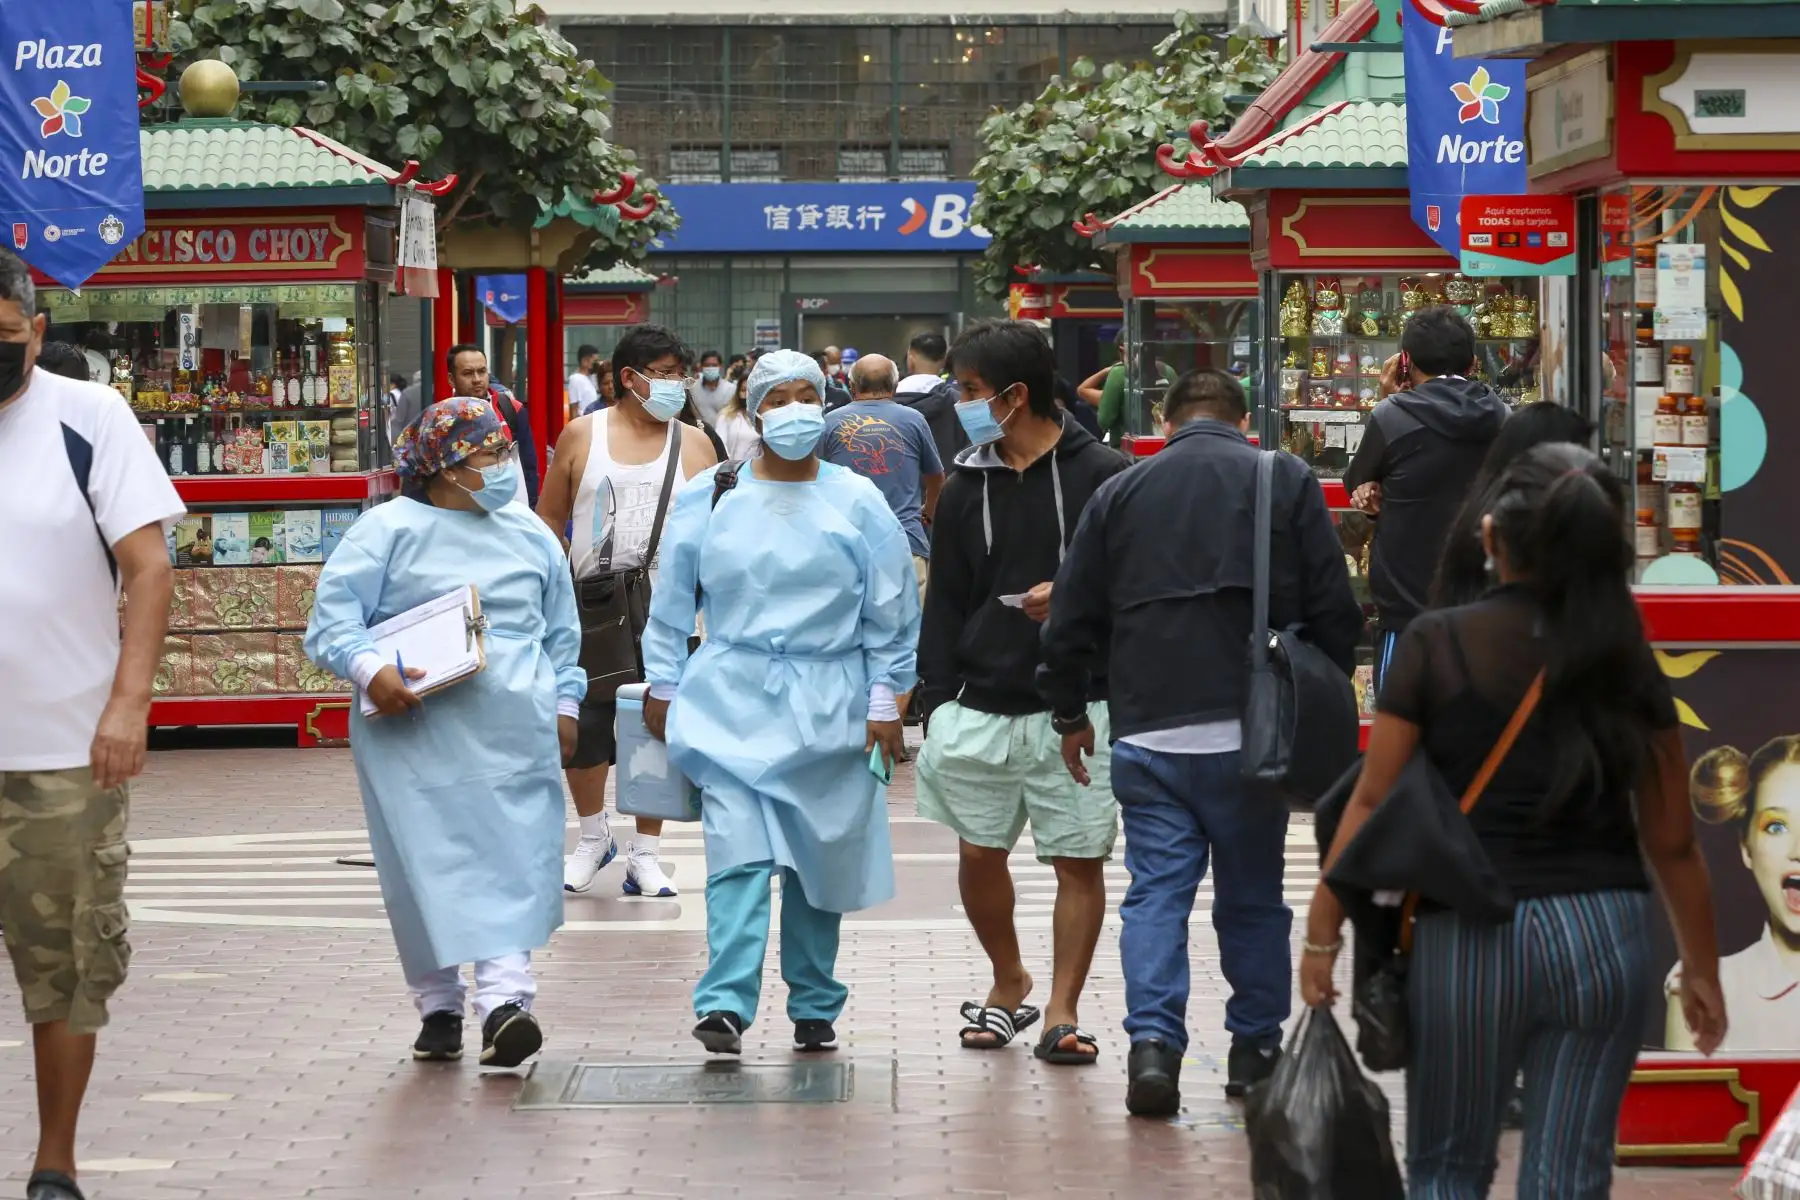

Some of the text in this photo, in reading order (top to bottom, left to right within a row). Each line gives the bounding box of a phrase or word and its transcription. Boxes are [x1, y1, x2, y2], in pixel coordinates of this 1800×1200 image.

[15, 39, 102, 71] Plaza
[1436, 134, 1524, 164] Norte
[22, 147, 108, 179] Norte
[763, 204, 886, 232] 信貸銀行
[1506, 208, 1552, 216] aceptamos
[1478, 217, 1559, 228] TODAS las tarjetas
[112, 228, 329, 262] NCISCO CHOY
[1472, 236, 1490, 244] VISA
[251, 515, 272, 525] Aloe
[325, 512, 354, 523] HIDRO
